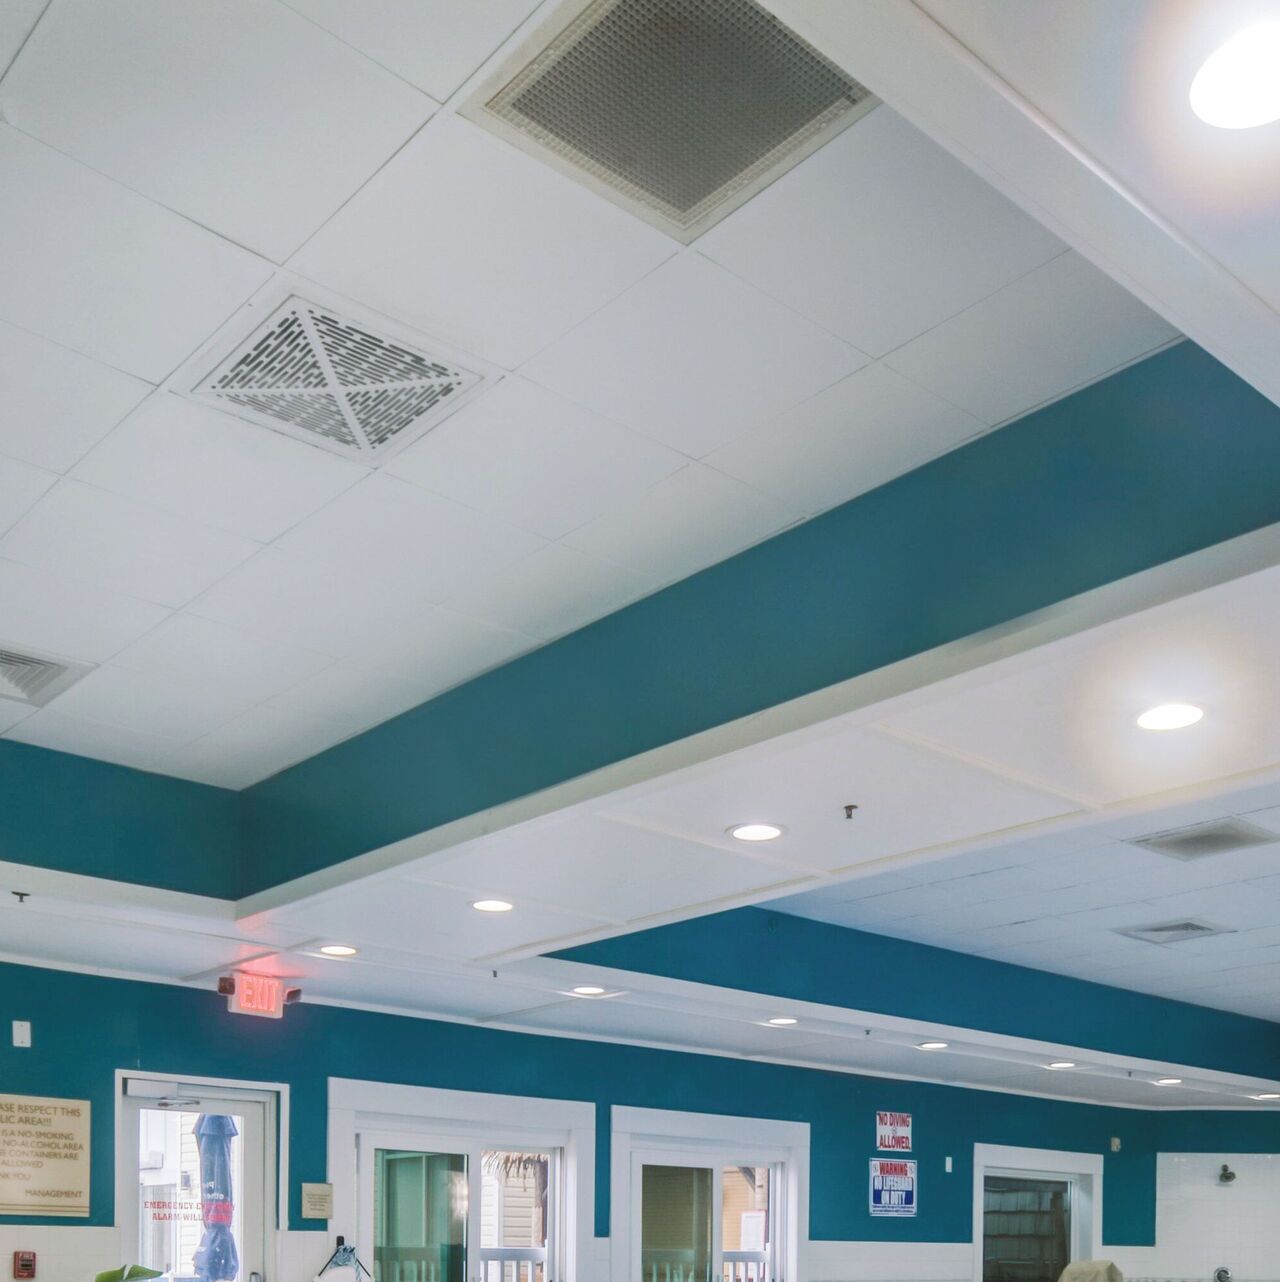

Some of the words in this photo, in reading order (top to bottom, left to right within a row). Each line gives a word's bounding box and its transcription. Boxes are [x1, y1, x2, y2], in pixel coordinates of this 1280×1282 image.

[241, 976, 278, 1011] EXIT
[17, 1104, 58, 1116] RESPECT
[60, 1107, 81, 1117] THIS
[879, 1113, 888, 1126] NO
[889, 1113, 910, 1128] DIVING
[8, 1149, 62, 1159] CONTAINERS
[63, 1152, 79, 1161] ARE
[2, 1159, 44, 1169] ALLOWED
[879, 1162, 908, 1176] WARNING
[12, 1172, 31, 1181] YOU
[25, 1189, 82, 1198] MANAGEMENT
[881, 1190, 890, 1205] ON
[890, 1191, 906, 1205] DUTY
[144, 1201, 193, 1210] EMERGENCY
[152, 1212, 180, 1221] ALARM
[183, 1213, 203, 1221] WILL
